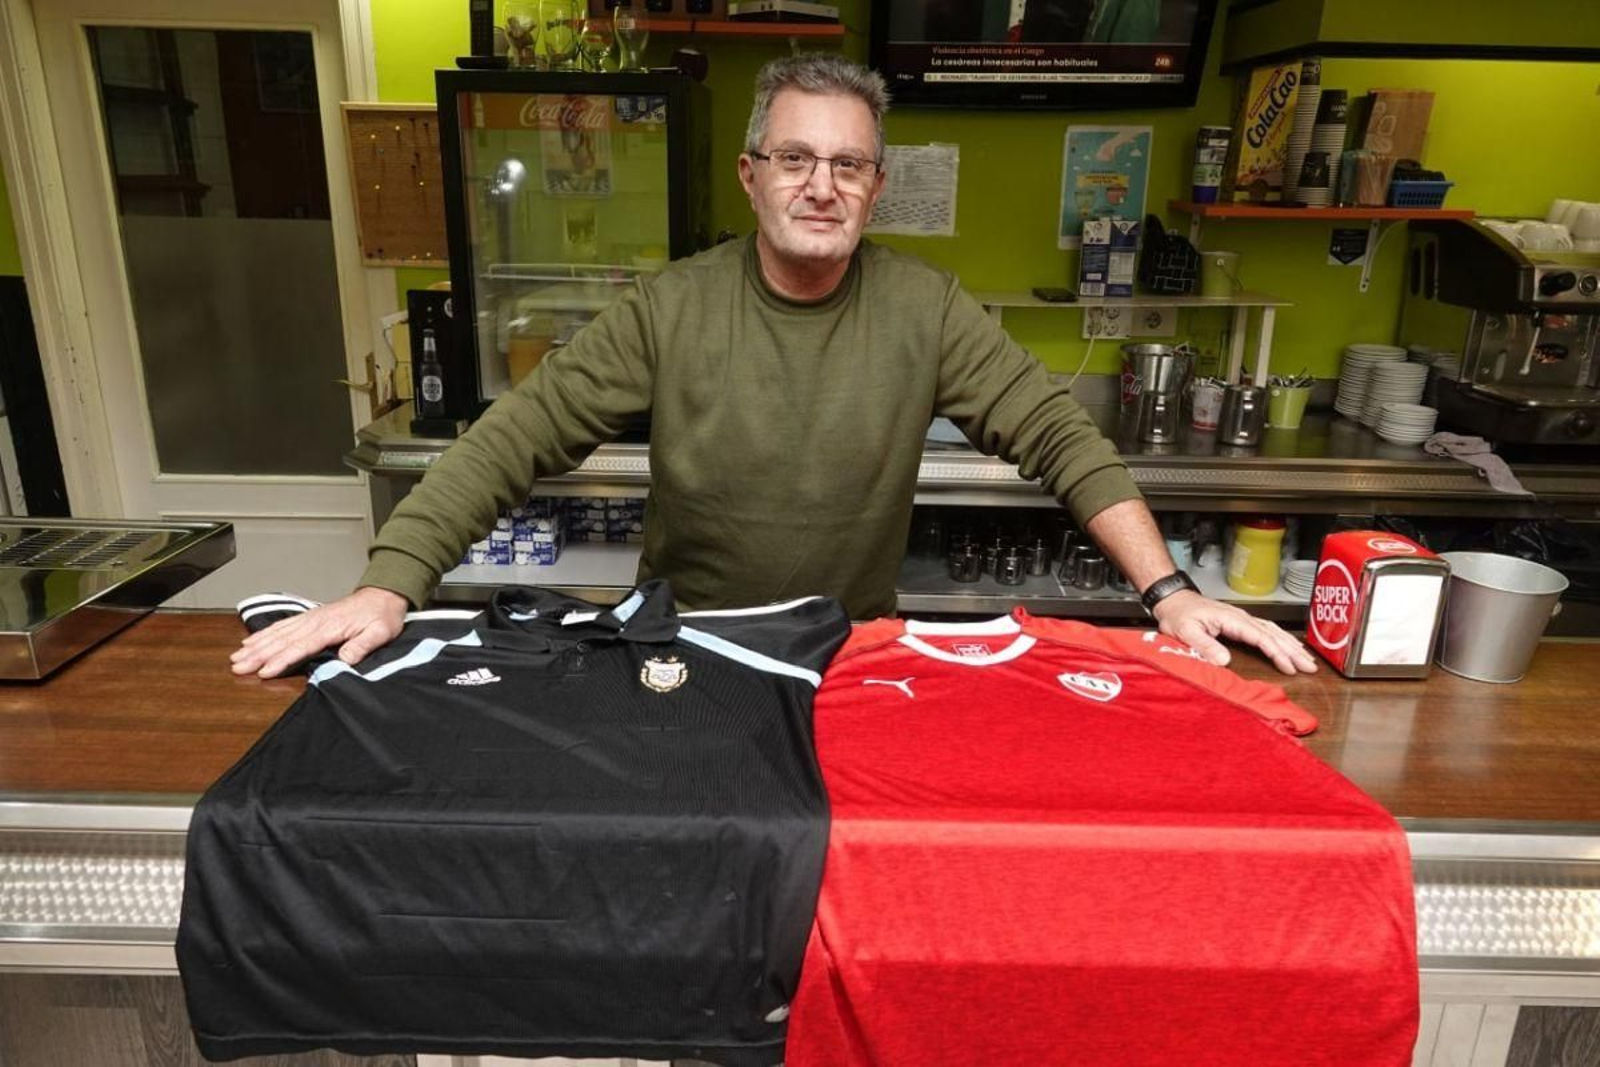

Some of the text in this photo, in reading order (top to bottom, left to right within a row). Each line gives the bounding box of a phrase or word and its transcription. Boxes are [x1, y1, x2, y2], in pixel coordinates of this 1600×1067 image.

[1037, 59, 1052, 67] son
[1053, 57, 1099, 68] habituales
[1314, 585, 1350, 604] SUPER
[1316, 604, 1349, 623] BOCK
